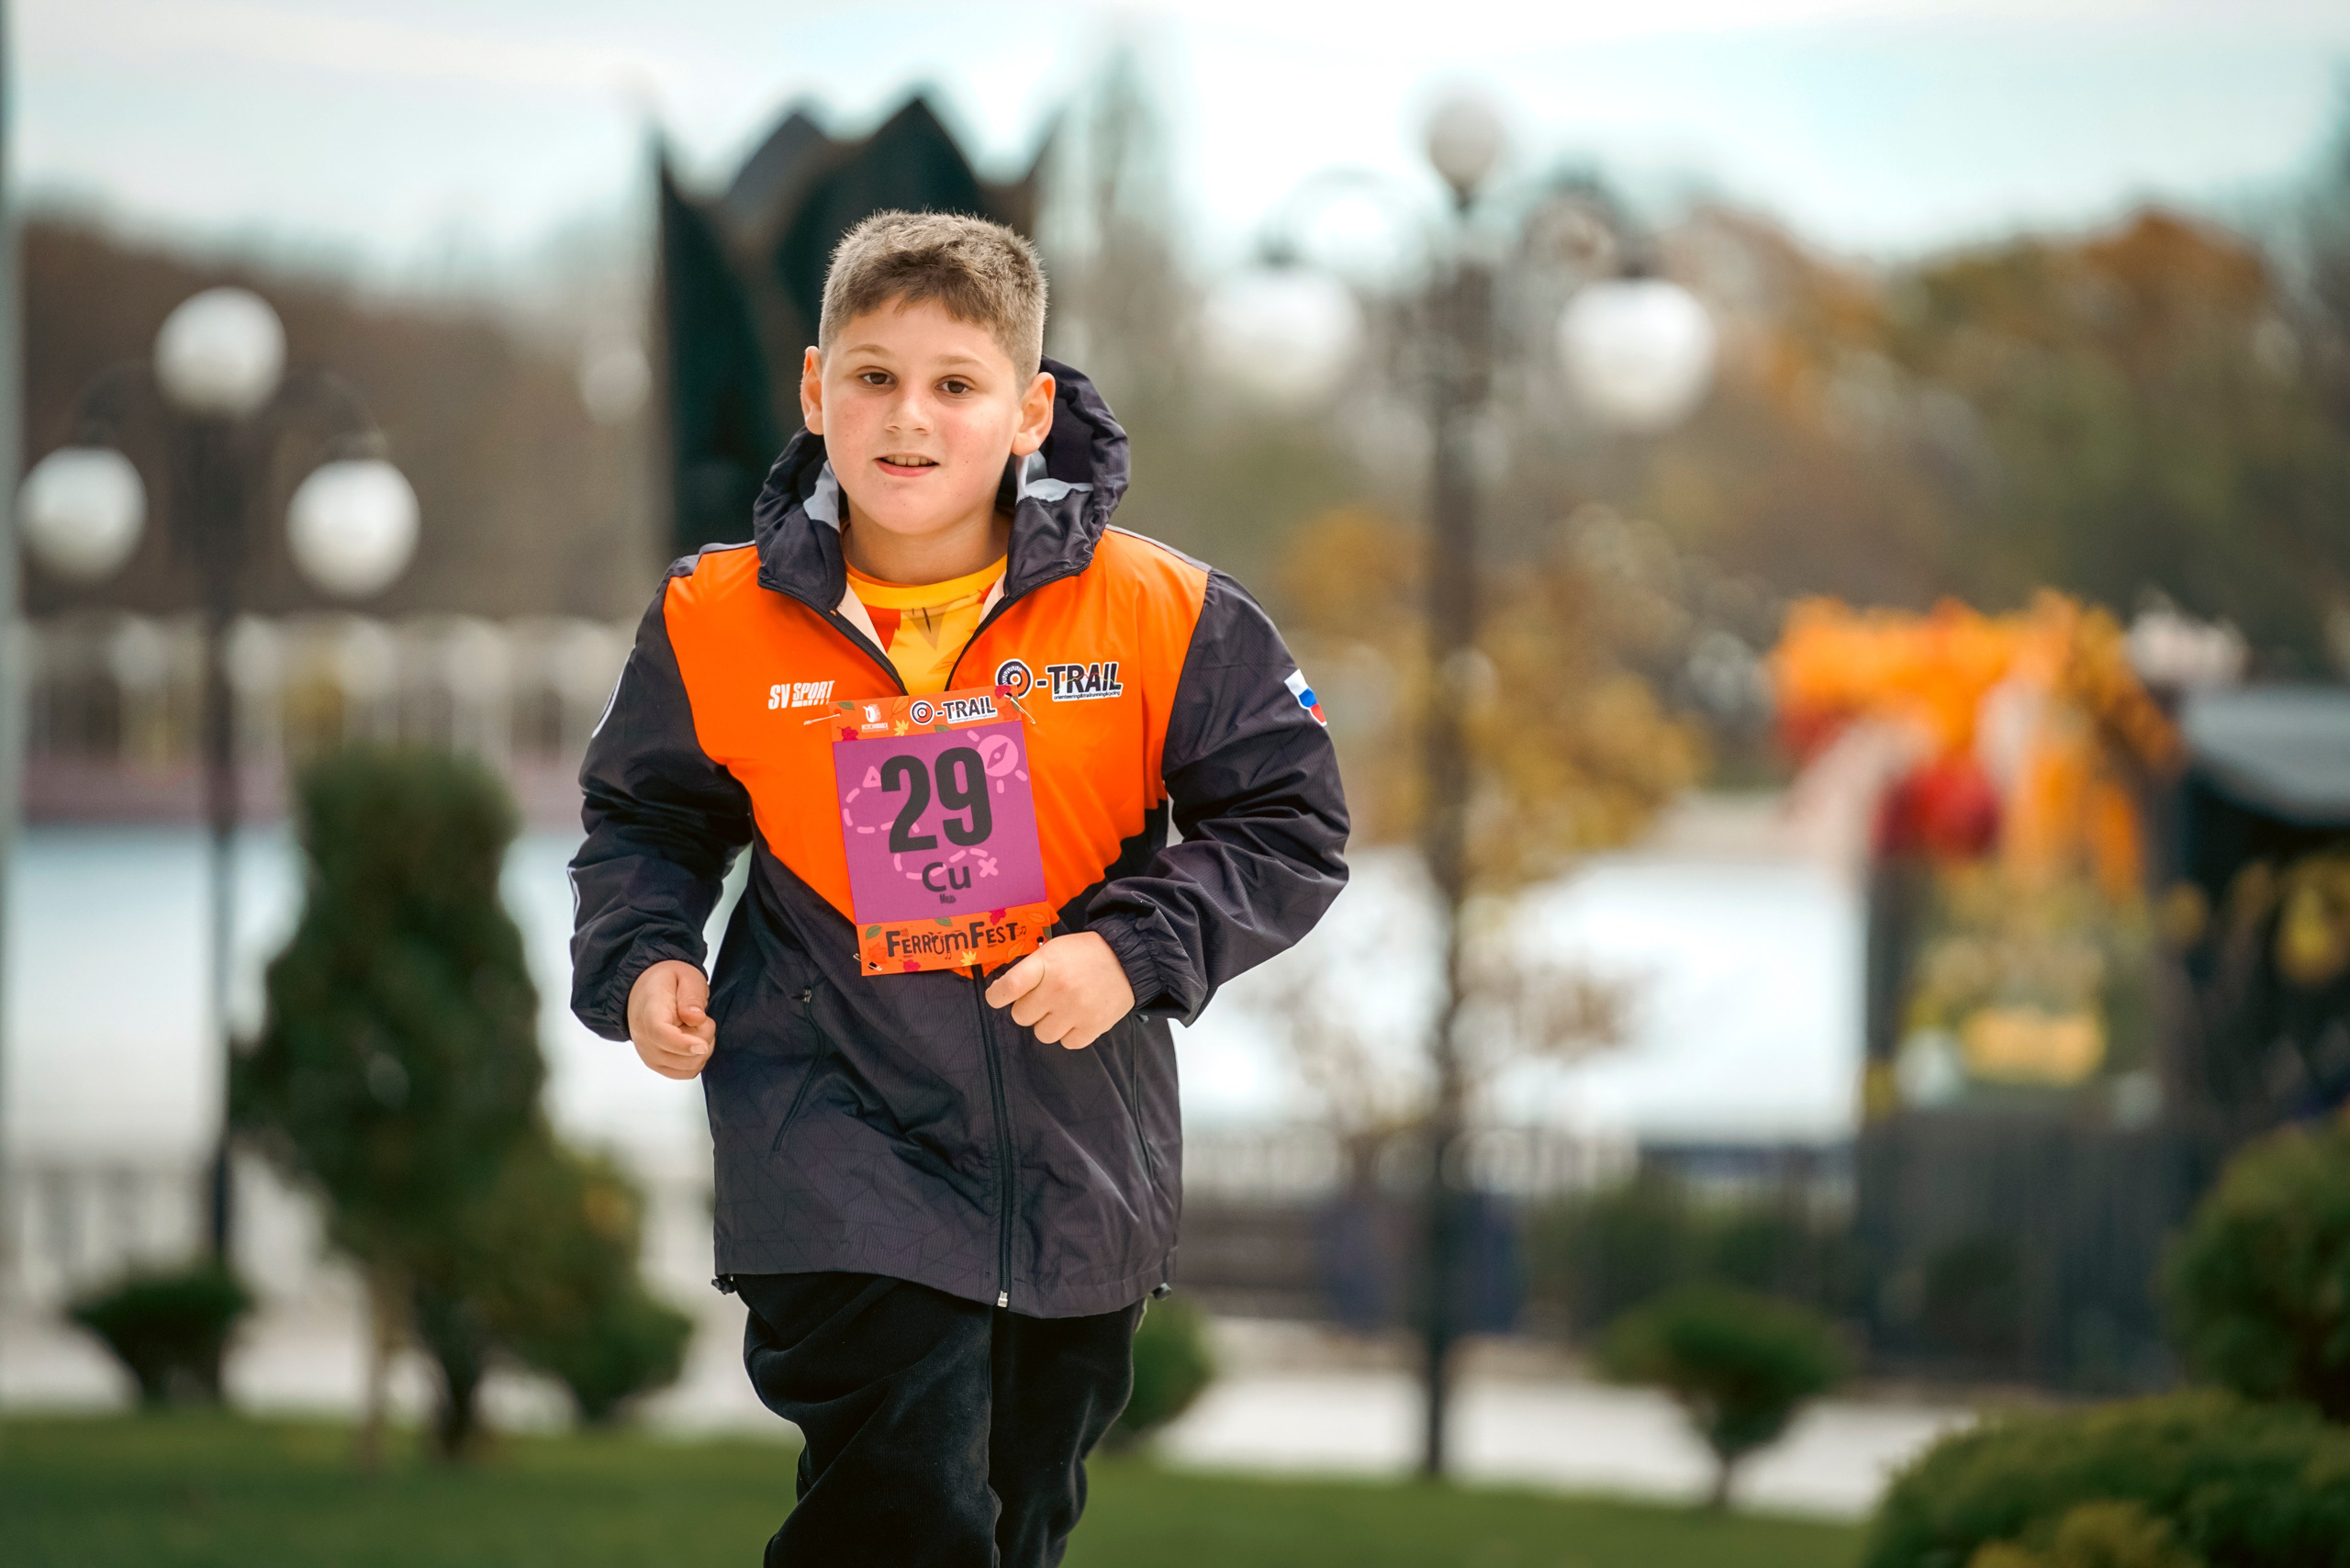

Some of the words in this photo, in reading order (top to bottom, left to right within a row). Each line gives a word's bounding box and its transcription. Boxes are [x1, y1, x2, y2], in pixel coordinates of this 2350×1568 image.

[768, 683, 790, 710] SV
[792, 680, 835, 700] SPORT
[880, 746, 992, 853] 29
[922, 861, 971, 892] Cu
